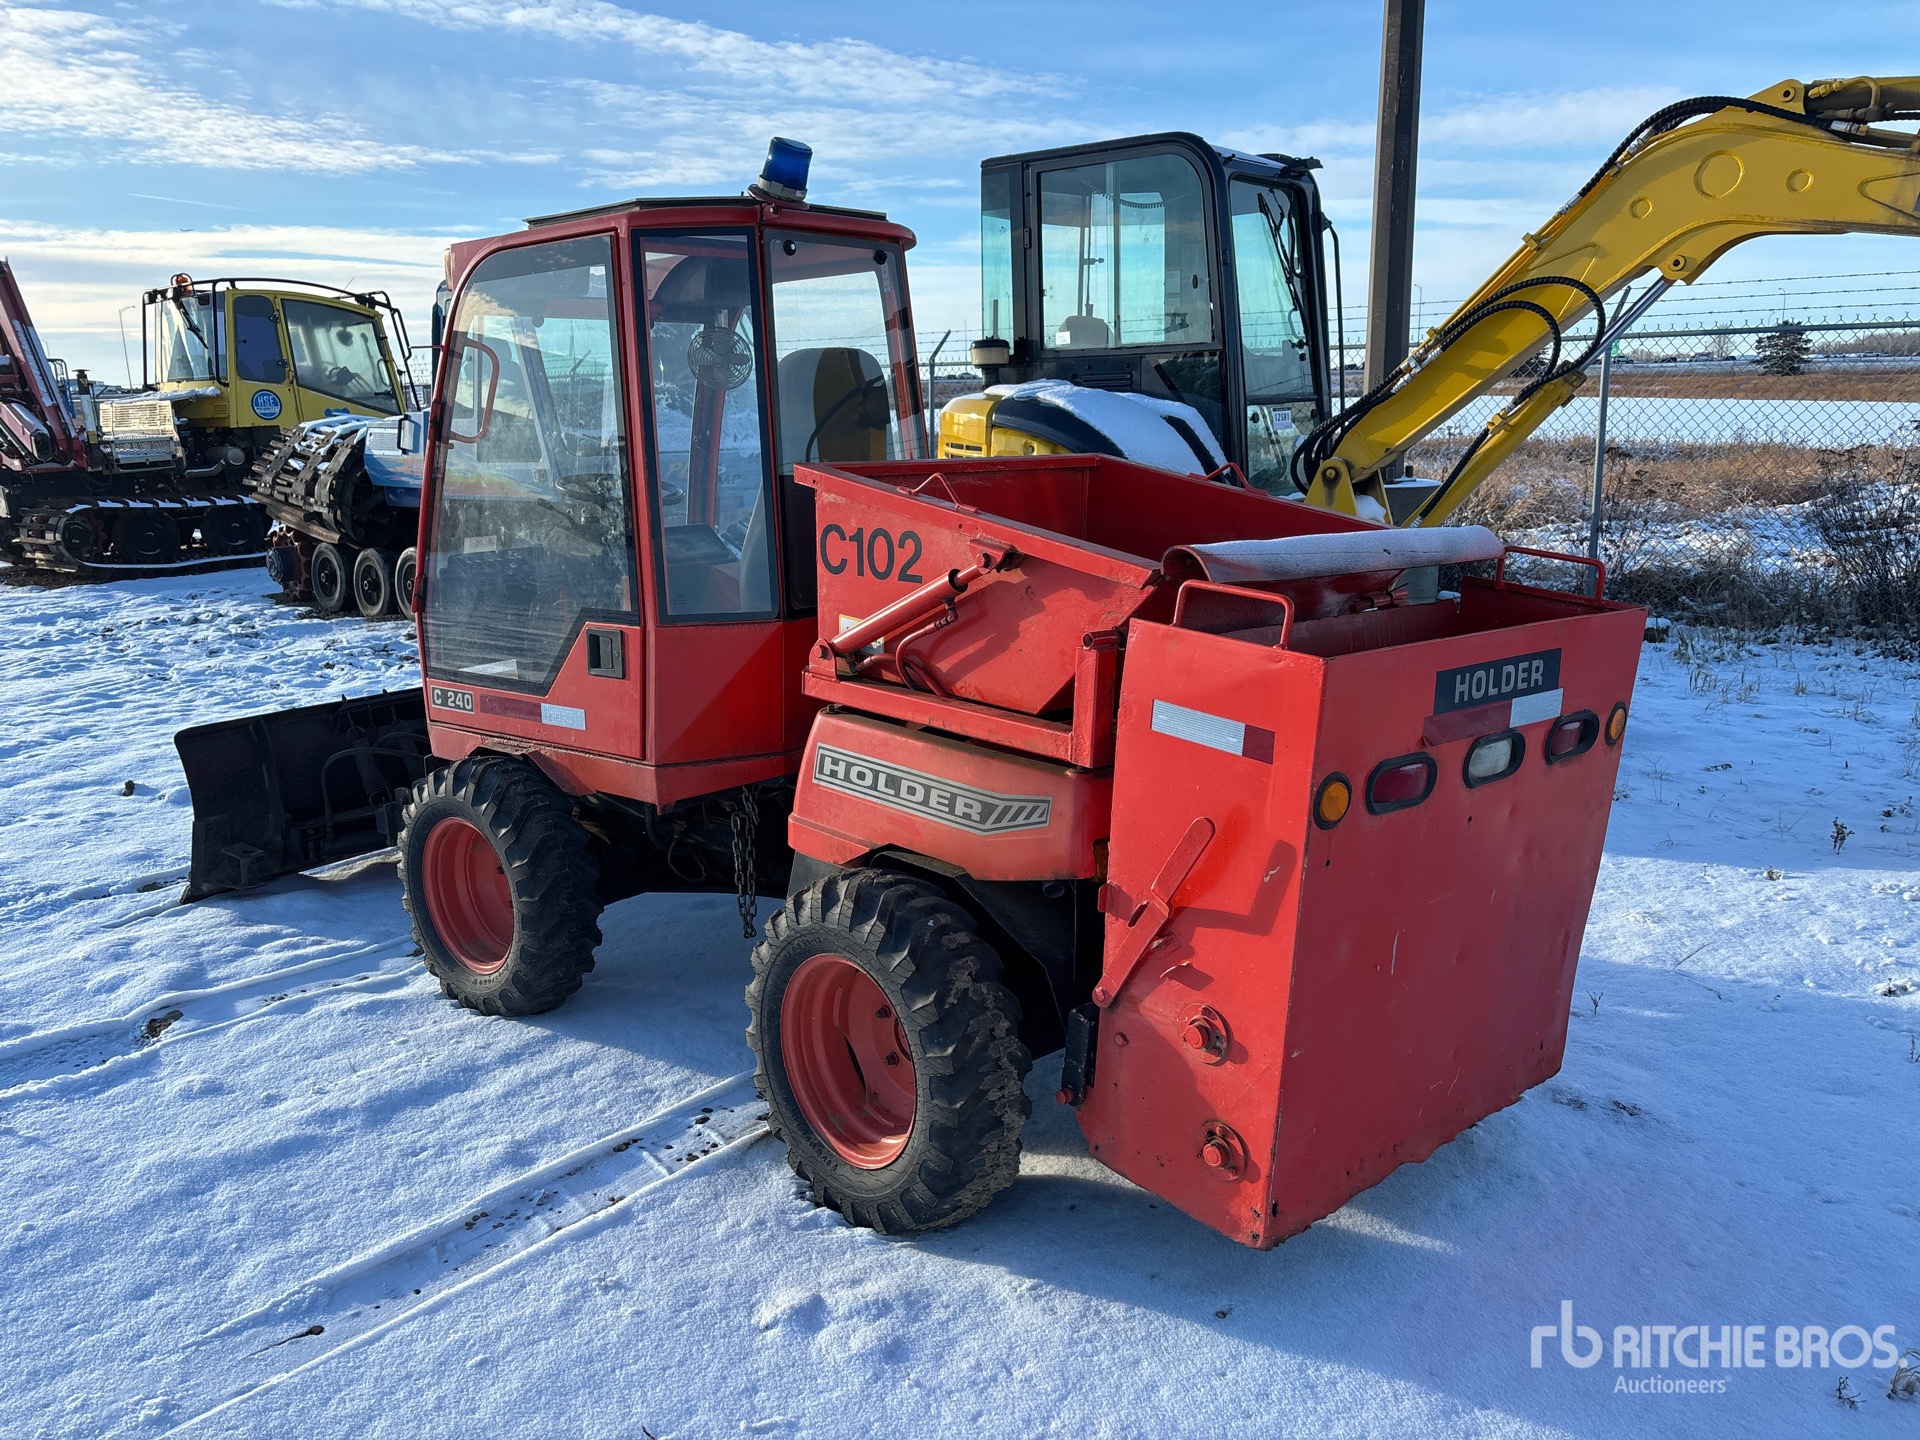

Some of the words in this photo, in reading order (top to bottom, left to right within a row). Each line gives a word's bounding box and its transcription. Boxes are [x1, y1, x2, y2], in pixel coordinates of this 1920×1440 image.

[257, 395, 275, 405] HSE
[1275, 413, 1290, 421] 12581
[820, 523, 922, 584] C102
[1454, 659, 1544, 703] HOLDER
[433, 689, 441, 704] C
[447, 691, 472, 709] 240
[823, 756, 981, 822] HOLDER
